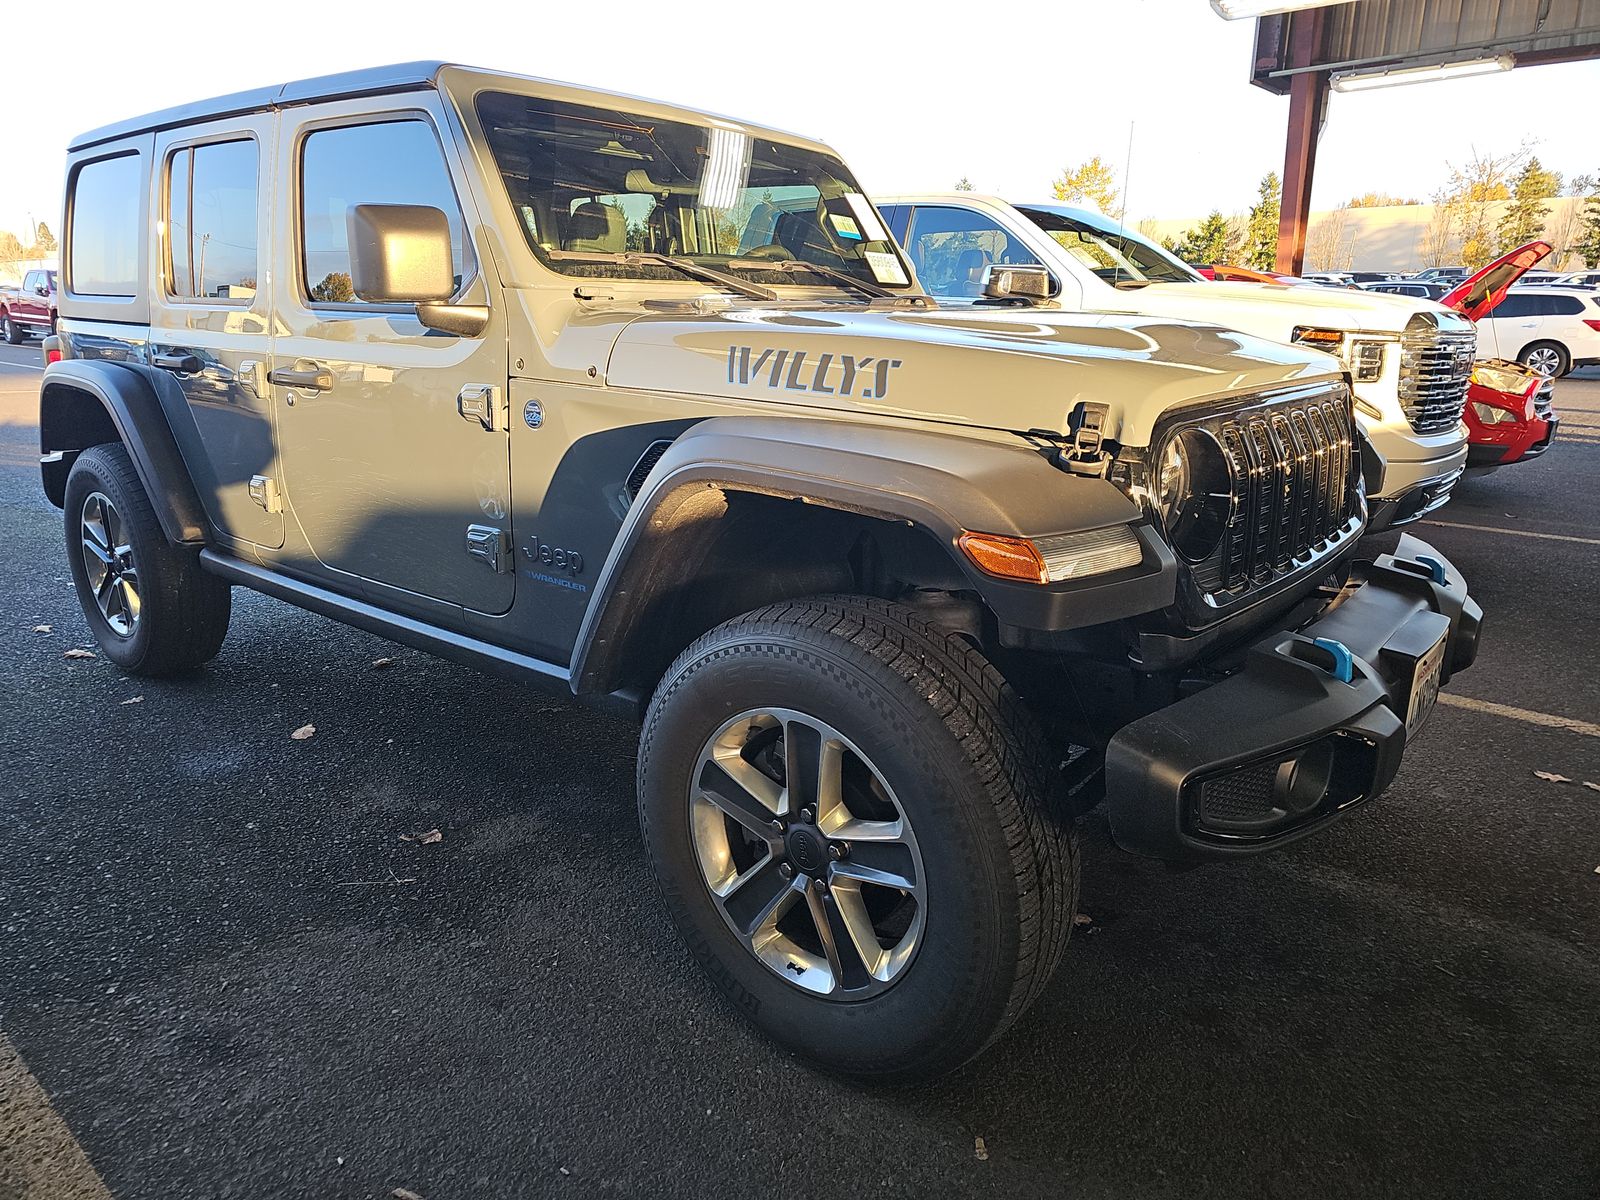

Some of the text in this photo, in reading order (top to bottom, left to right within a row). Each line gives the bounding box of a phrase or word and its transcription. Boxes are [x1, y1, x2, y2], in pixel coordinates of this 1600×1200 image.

[727, 345, 903, 398] WILLYS
[522, 535, 585, 577] Jeep
[530, 571, 586, 593] WRANGLER
